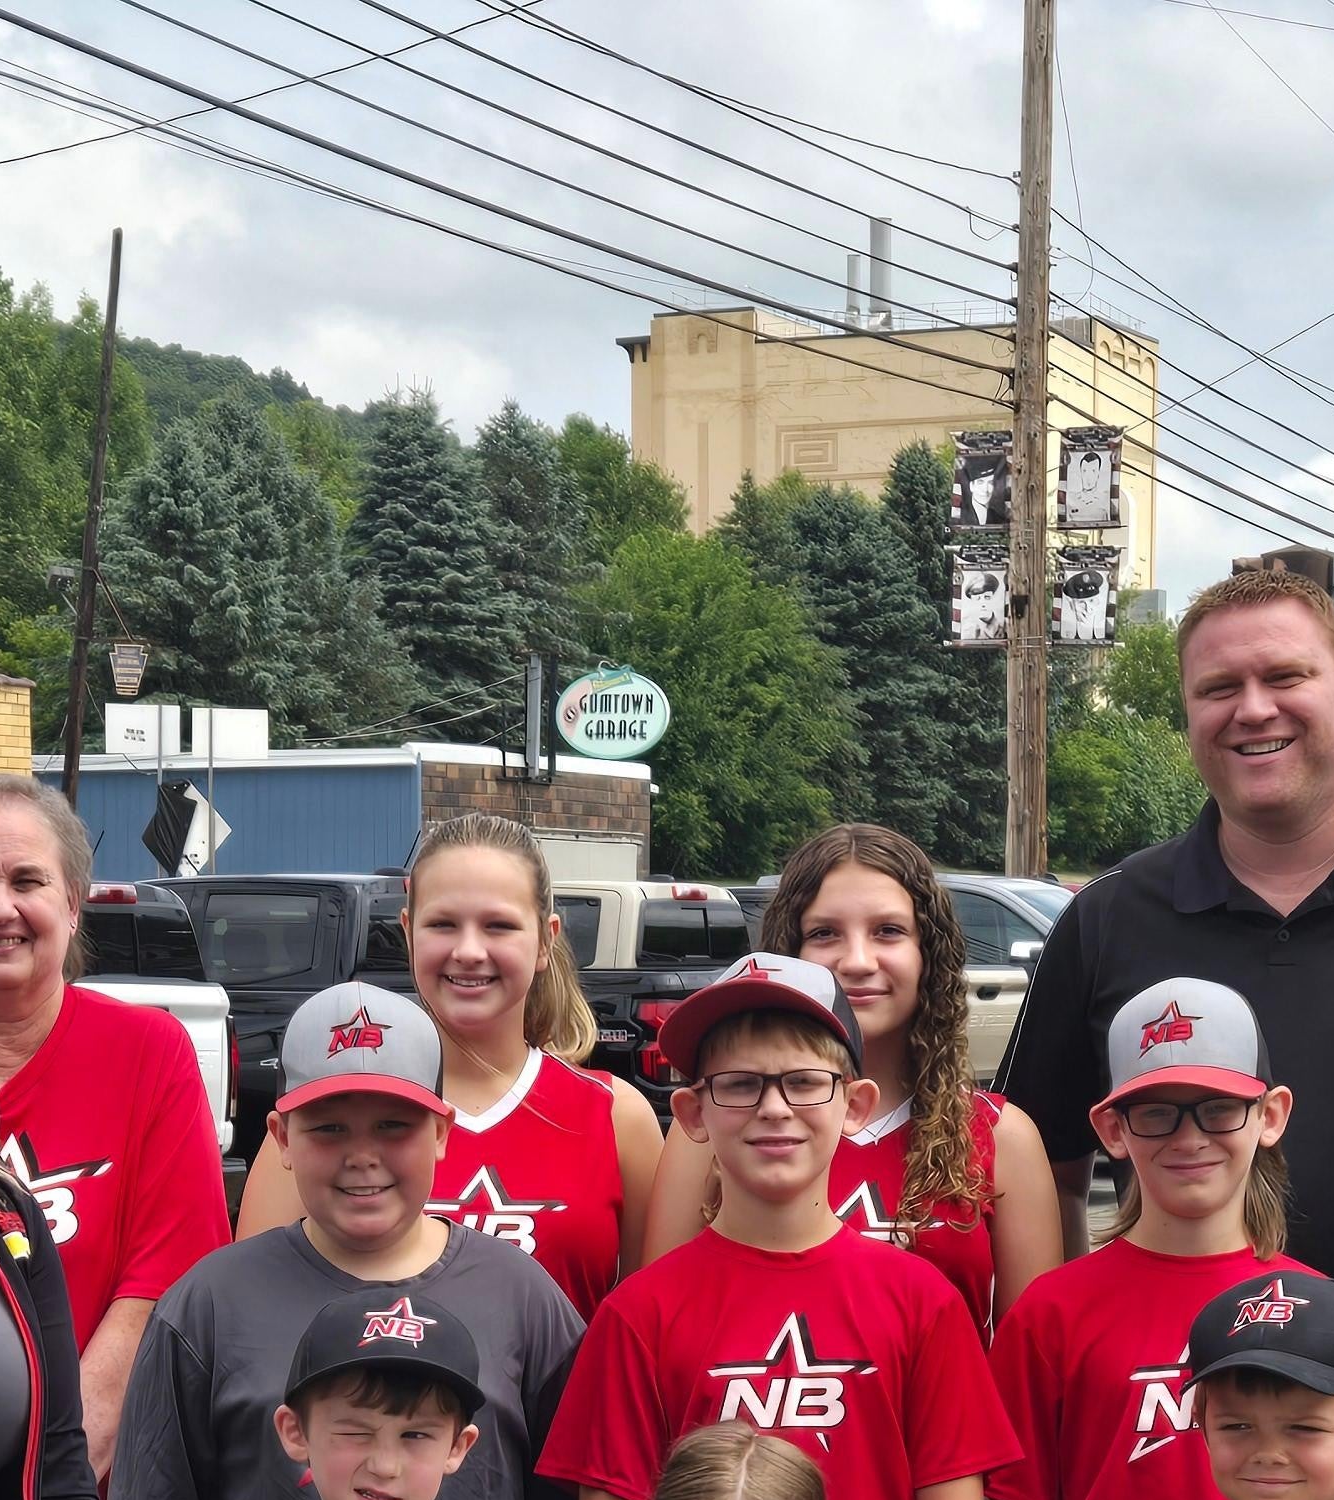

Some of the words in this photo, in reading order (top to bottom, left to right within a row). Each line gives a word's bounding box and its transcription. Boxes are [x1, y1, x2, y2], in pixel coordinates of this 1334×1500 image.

[579, 693, 654, 715] GUMTOWN
[585, 719, 648, 740] GARAGE
[327, 1027, 383, 1052] NB
[1139, 1020, 1193, 1050] NB
[1233, 1301, 1294, 1327] NB
[363, 1316, 424, 1342] NB
[719, 1377, 846, 1428] NB
[1135, 1382, 1199, 1431] N
